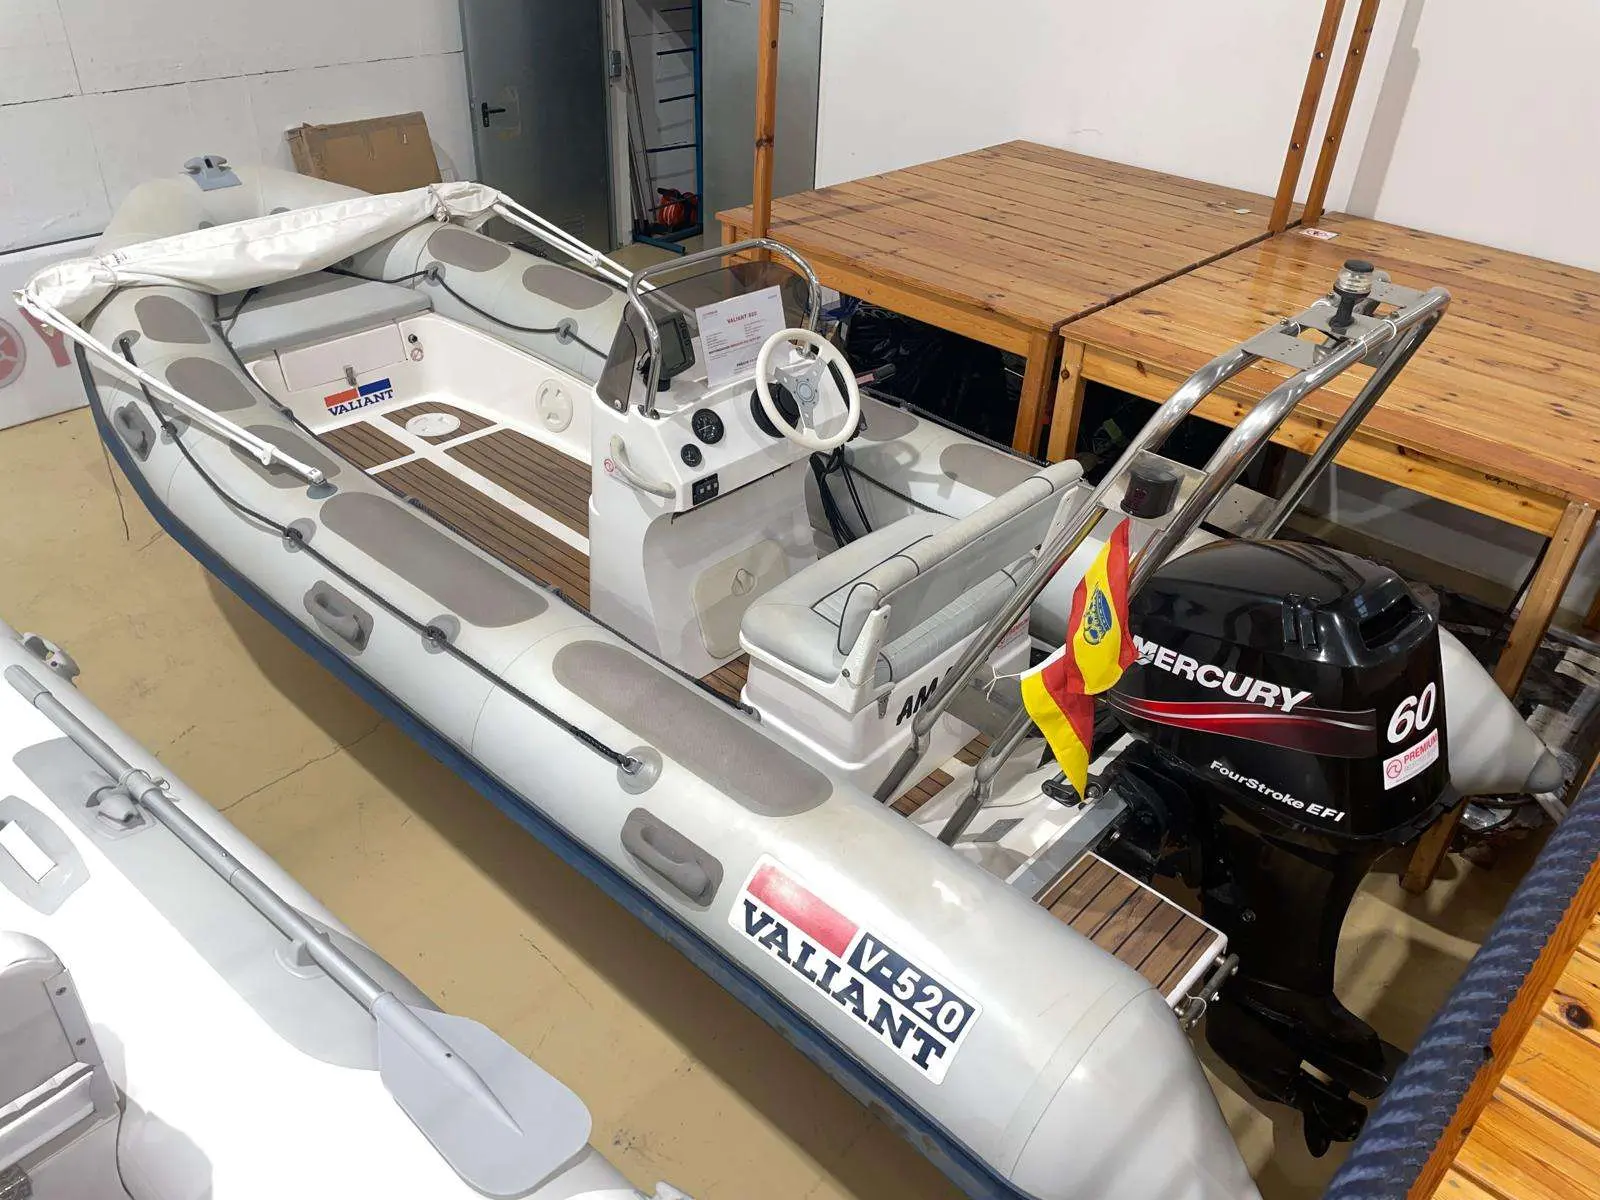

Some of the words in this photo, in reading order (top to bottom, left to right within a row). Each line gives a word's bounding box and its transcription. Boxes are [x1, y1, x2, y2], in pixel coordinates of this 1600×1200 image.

[328, 389, 393, 416] VALIANT
[1133, 634, 1312, 713] MERCURY
[1387, 681, 1436, 744] 60
[1403, 734, 1438, 764] PREMIUM
[1210, 760, 1305, 809] FourStroke
[1306, 803, 1345, 822] EFI
[743, 898, 947, 1071] VALIANT
[860, 938, 965, 1034] V-520
